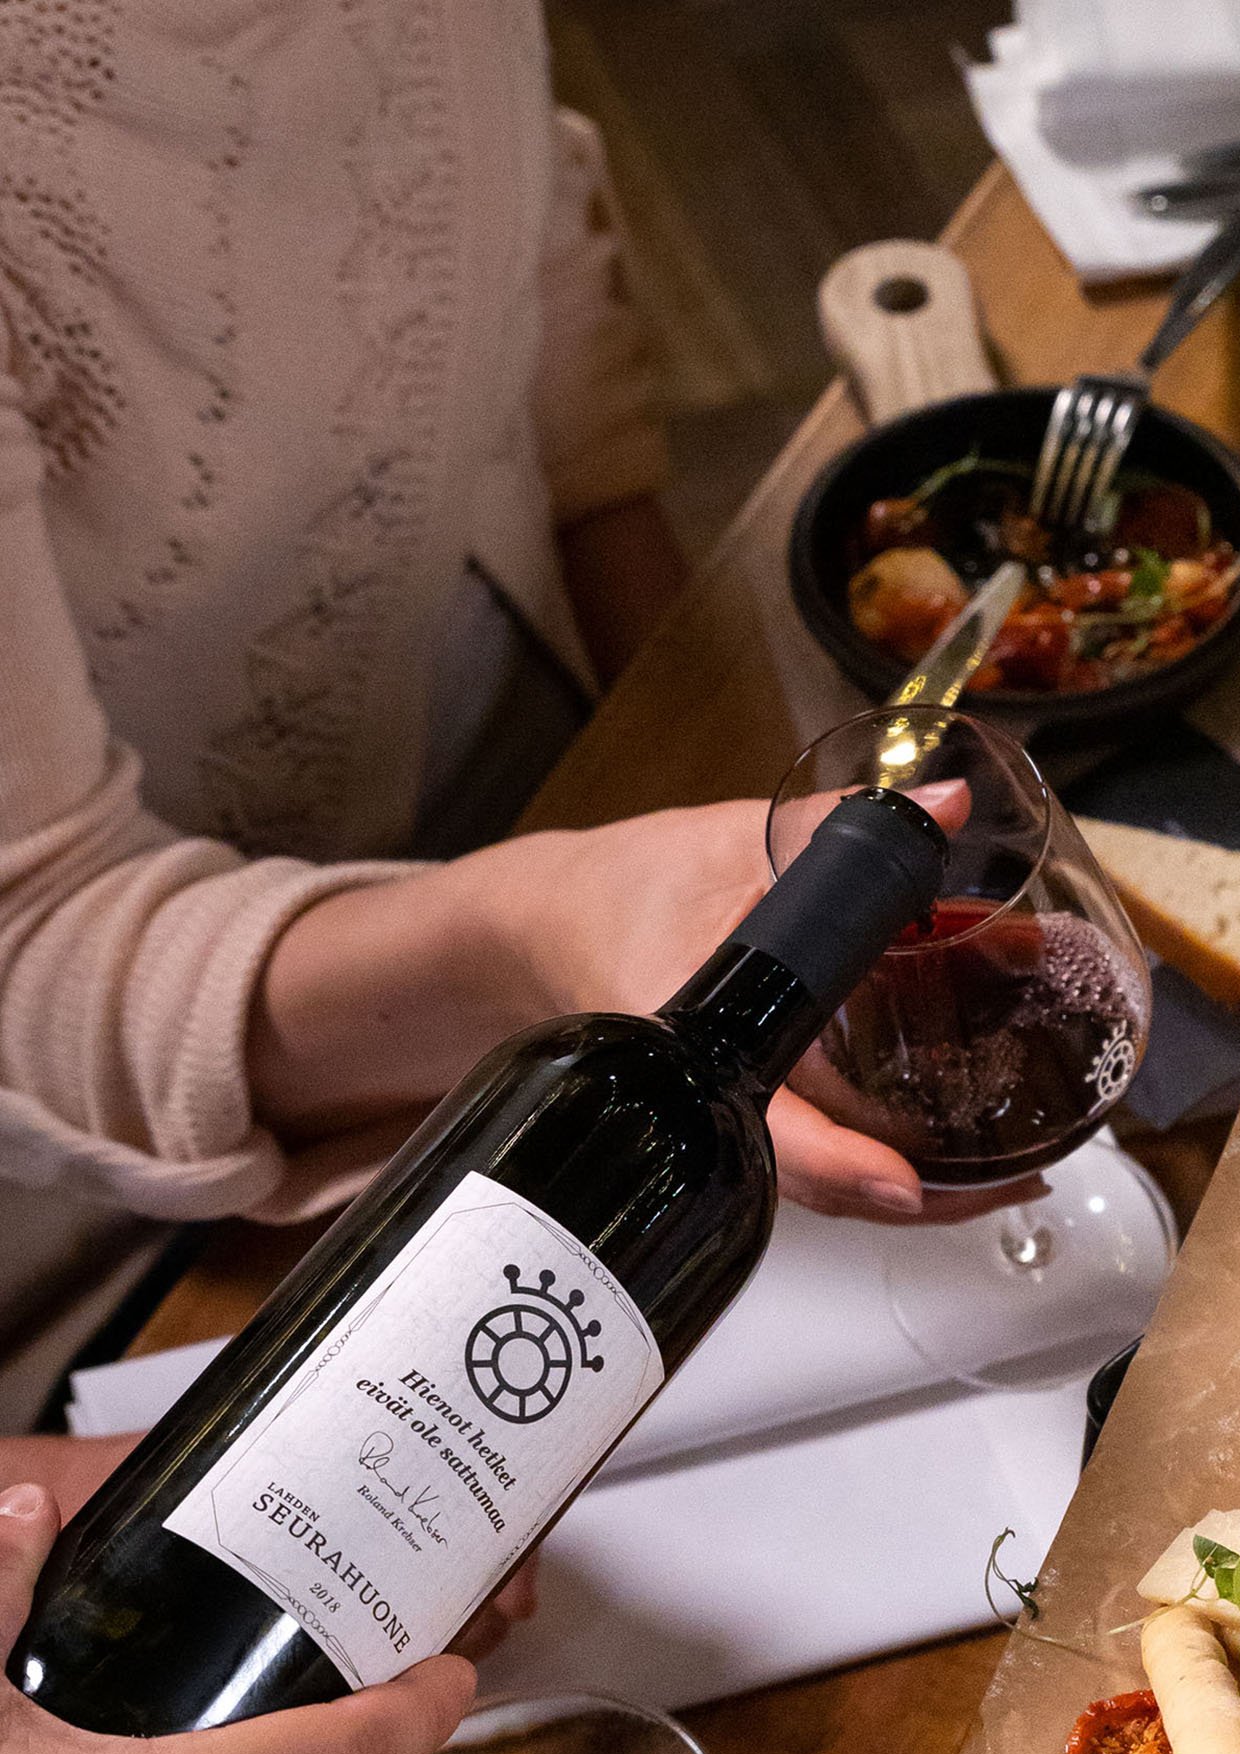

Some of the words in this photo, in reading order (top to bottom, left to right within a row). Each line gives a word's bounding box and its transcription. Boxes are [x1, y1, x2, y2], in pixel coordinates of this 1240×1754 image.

[356, 1378, 414, 1421] eivät
[411, 1419, 442, 1448] ole
[439, 1447, 506, 1534] sattumaa
[398, 1368, 474, 1435] Hienot
[467, 1428, 518, 1492] hetket
[267, 1481, 321, 1523] LAHDEN
[356, 1484, 395, 1520] Roland
[391, 1517, 423, 1553] Krebser
[252, 1493, 411, 1654] SEURAHUONE
[309, 1582, 341, 1614] 2018
